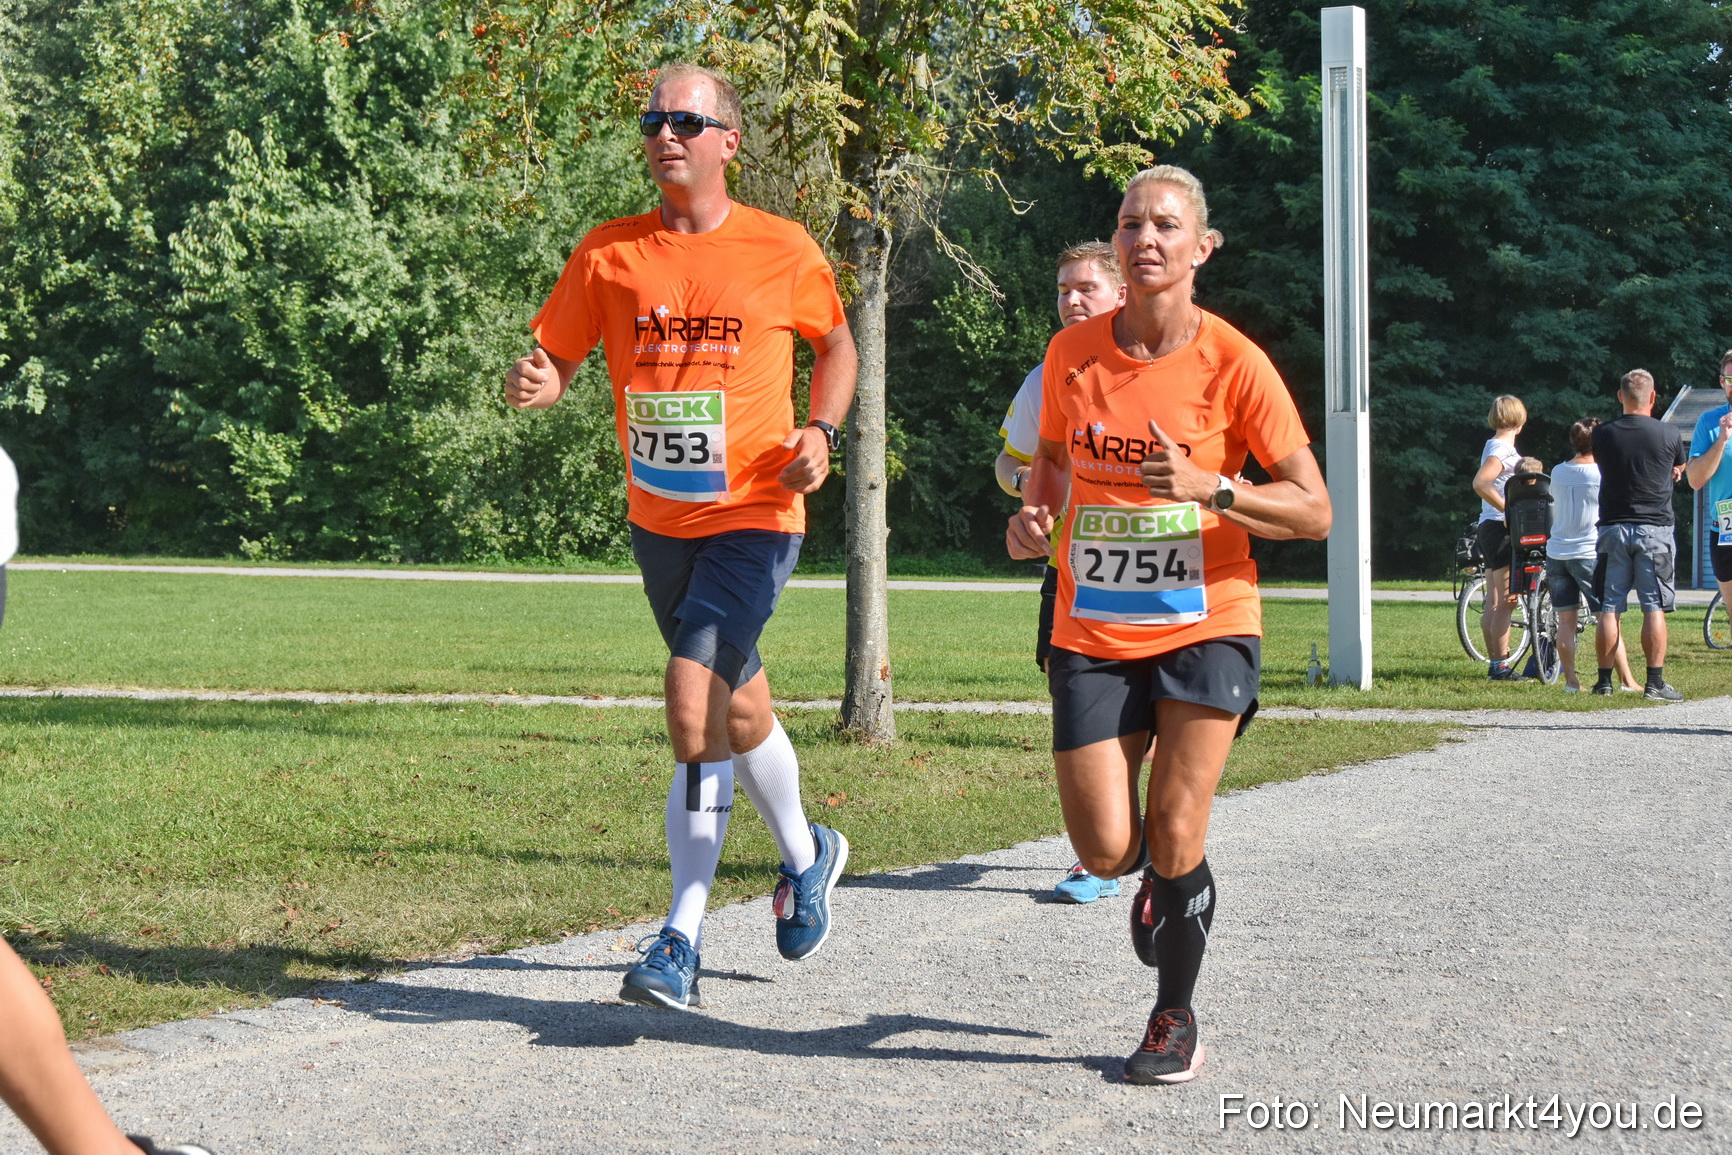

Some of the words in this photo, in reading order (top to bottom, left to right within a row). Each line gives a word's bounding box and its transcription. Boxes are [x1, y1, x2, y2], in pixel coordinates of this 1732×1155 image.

[634, 343, 741, 354] ELEKTROTECHNIK
[1065, 359, 1091, 386] CRAFT
[628, 425, 710, 465] 2753
[1081, 511, 1187, 536] BOCK
[1084, 548, 1188, 584] 2754
